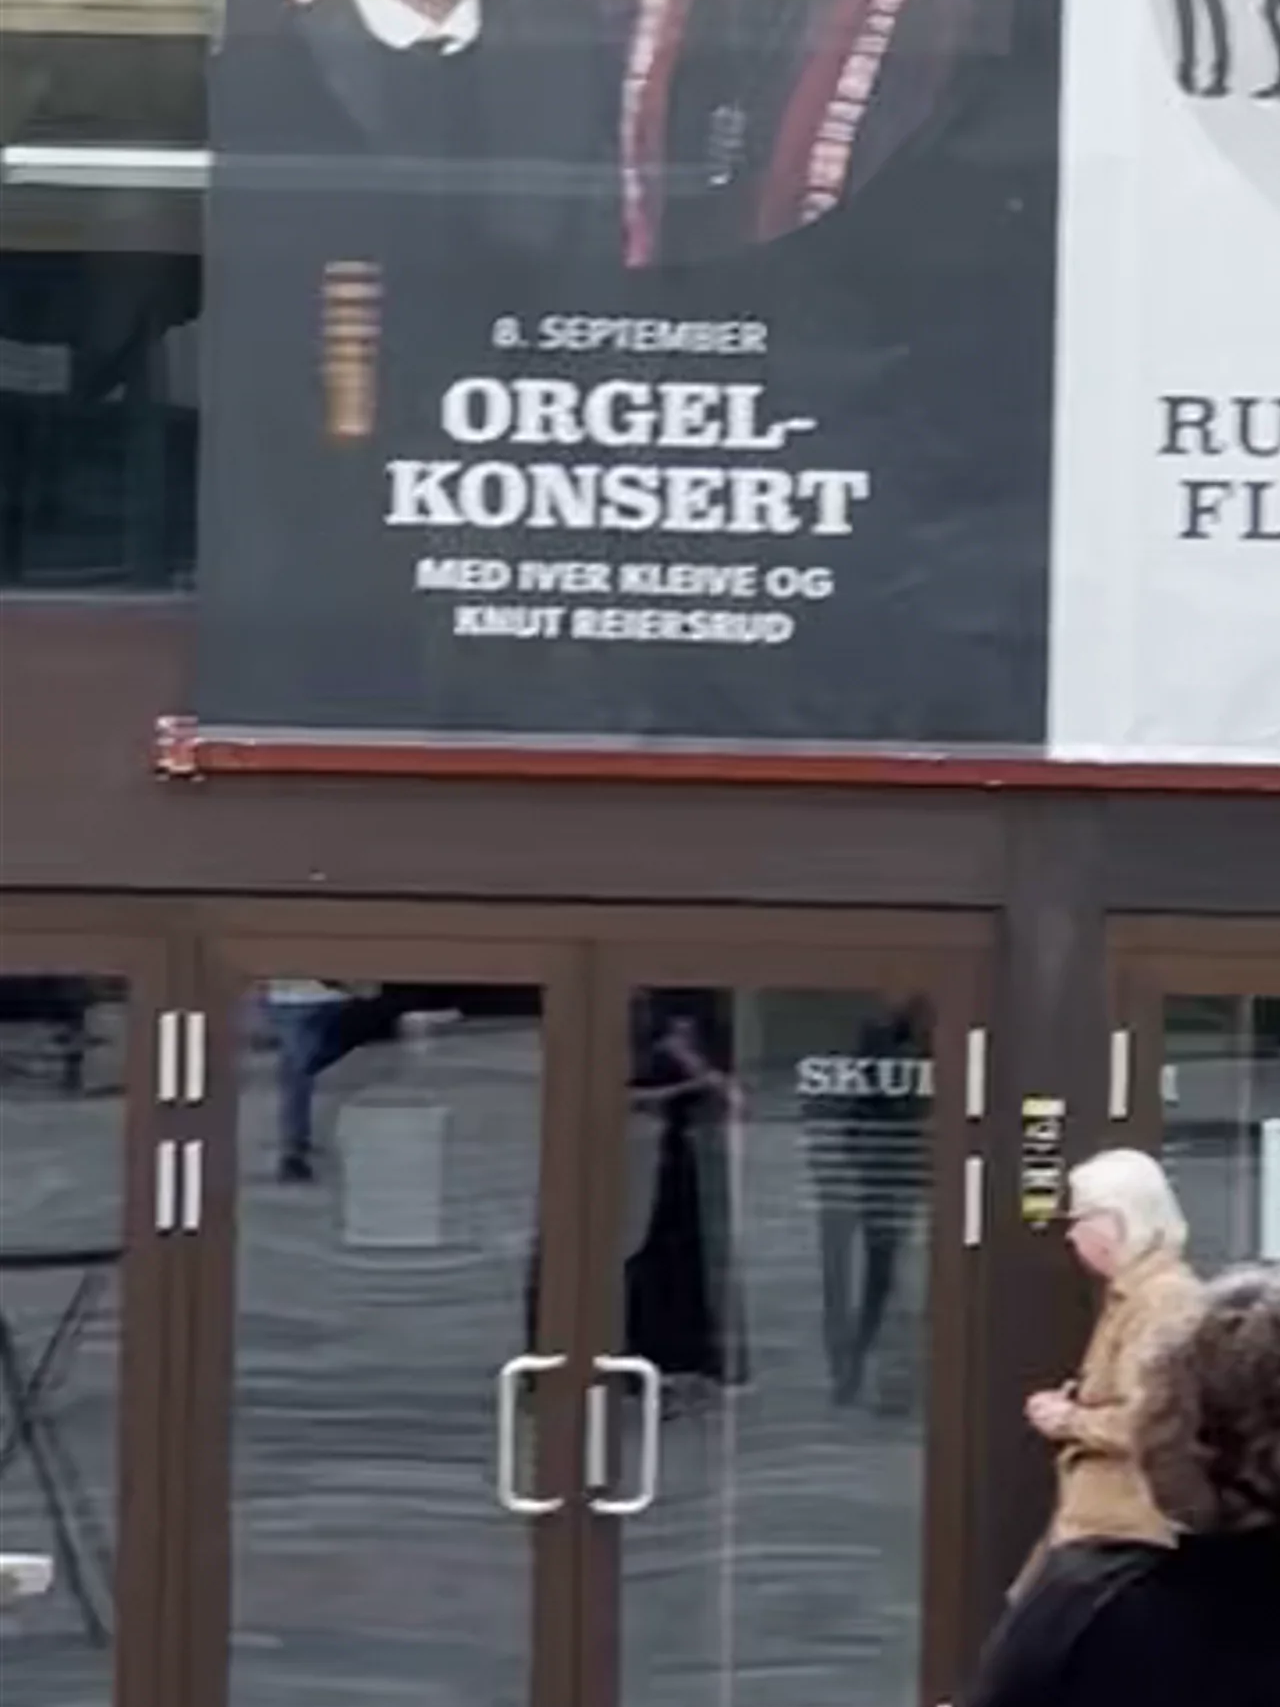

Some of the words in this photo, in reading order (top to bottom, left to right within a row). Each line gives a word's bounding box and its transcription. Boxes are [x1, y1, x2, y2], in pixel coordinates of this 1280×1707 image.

[491, 316, 529, 349] 8.
[539, 316, 769, 354] SEPTEMBER
[441, 376, 818, 449] ORGEL-
[383, 459, 871, 535] KONSERT
[415, 557, 511, 592] MED
[517, 561, 611, 595] IVER
[619, 563, 758, 597] KLEIVE
[766, 566, 835, 601] OG
[453, 605, 567, 639] KNUT
[571, 607, 796, 646] REIERSRUD
